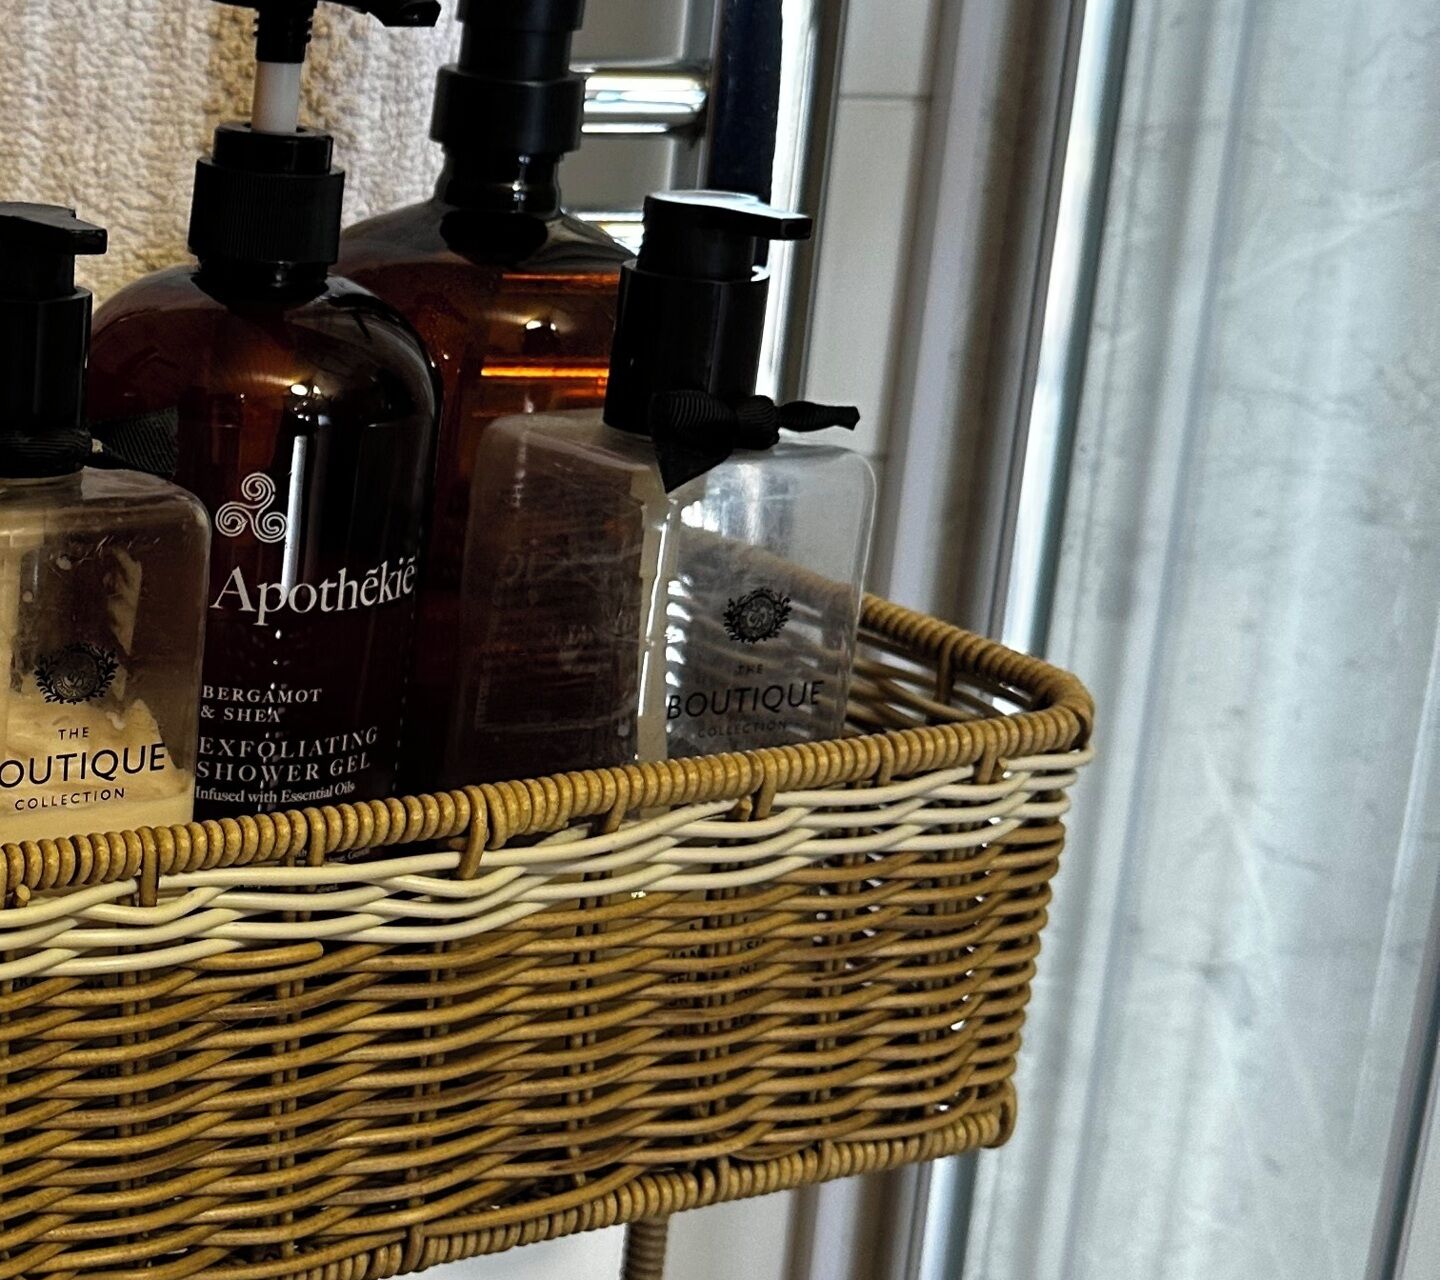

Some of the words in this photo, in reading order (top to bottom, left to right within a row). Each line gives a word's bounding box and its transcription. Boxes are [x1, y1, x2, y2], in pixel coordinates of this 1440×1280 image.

[201, 684, 322, 704] BERGAMOT
[666, 680, 825, 720] BOUTIQUE
[199, 705, 216, 719] &
[223, 706, 281, 723] SHEA
[59, 726, 89, 741] THE
[698, 720, 787, 738] COLLECTION
[198, 726, 378, 759] EXFOLIATING
[196, 760, 320, 783] SHOWER
[329, 751, 371, 776] GEL
[14, 787, 126, 812] COLLECTION
[195, 785, 245, 803] Infused
[247, 788, 277, 803] with
[280, 785, 333, 804] Essential
[334, 780, 356, 797] Oils
